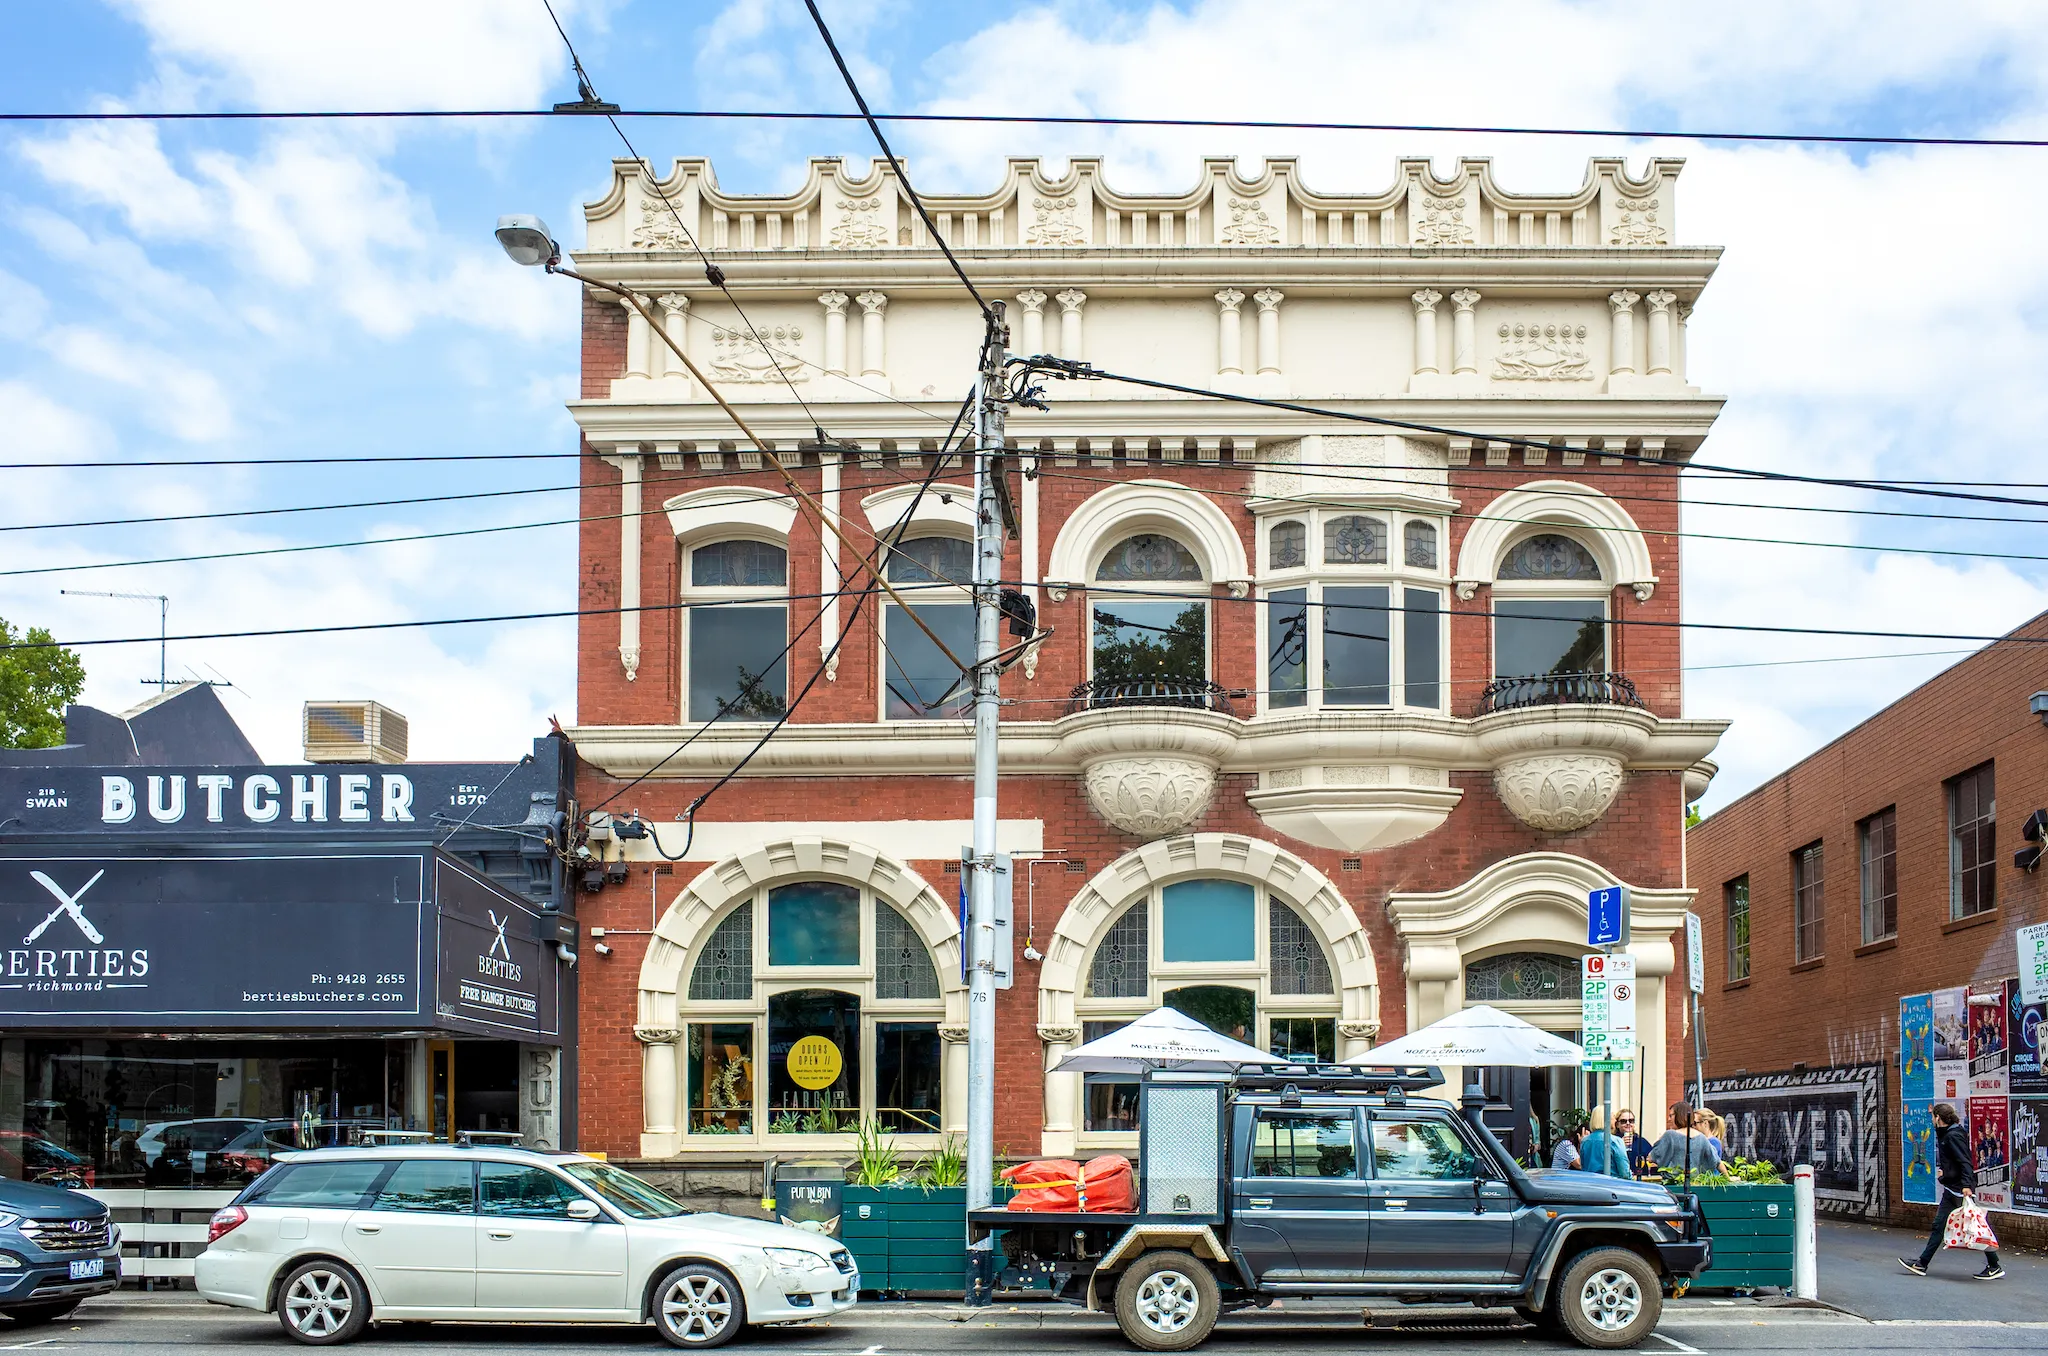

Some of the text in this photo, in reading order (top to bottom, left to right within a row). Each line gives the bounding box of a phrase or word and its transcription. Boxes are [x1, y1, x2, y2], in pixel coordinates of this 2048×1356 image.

[38, 788, 55, 796] 218
[459, 785, 478, 793] EST
[26, 797, 68, 808] SWAN
[101, 774, 415, 823] BUTCHER
[450, 794, 487, 806] 1870
[1600, 891, 1609, 909] P
[2036, 940, 2045, 951] P
[0, 949, 149, 977] ERTIES
[478, 954, 522, 983] BERTIES
[311, 974, 406, 984] Ph: 9428 2655
[27, 980, 103, 991] richmond
[1585, 982, 1606, 994] 2P
[242, 991, 403, 1002] bertiesbutchers.com
[460, 985, 537, 1013] FREE RANGE BUTCHER
[972, 992, 987, 1003] 76
[1585, 1034, 1606, 1046] 2P
[801, 1044, 828, 1055] DOORS
[798, 1055, 818, 1065] OPEN
[2014, 1053, 2034, 1063] CIRQUE
[530, 1051, 552, 1147] BUT
[791, 1186, 831, 1199] PUT IN BIN
[2015, 1193, 2033, 1202] CORNER
